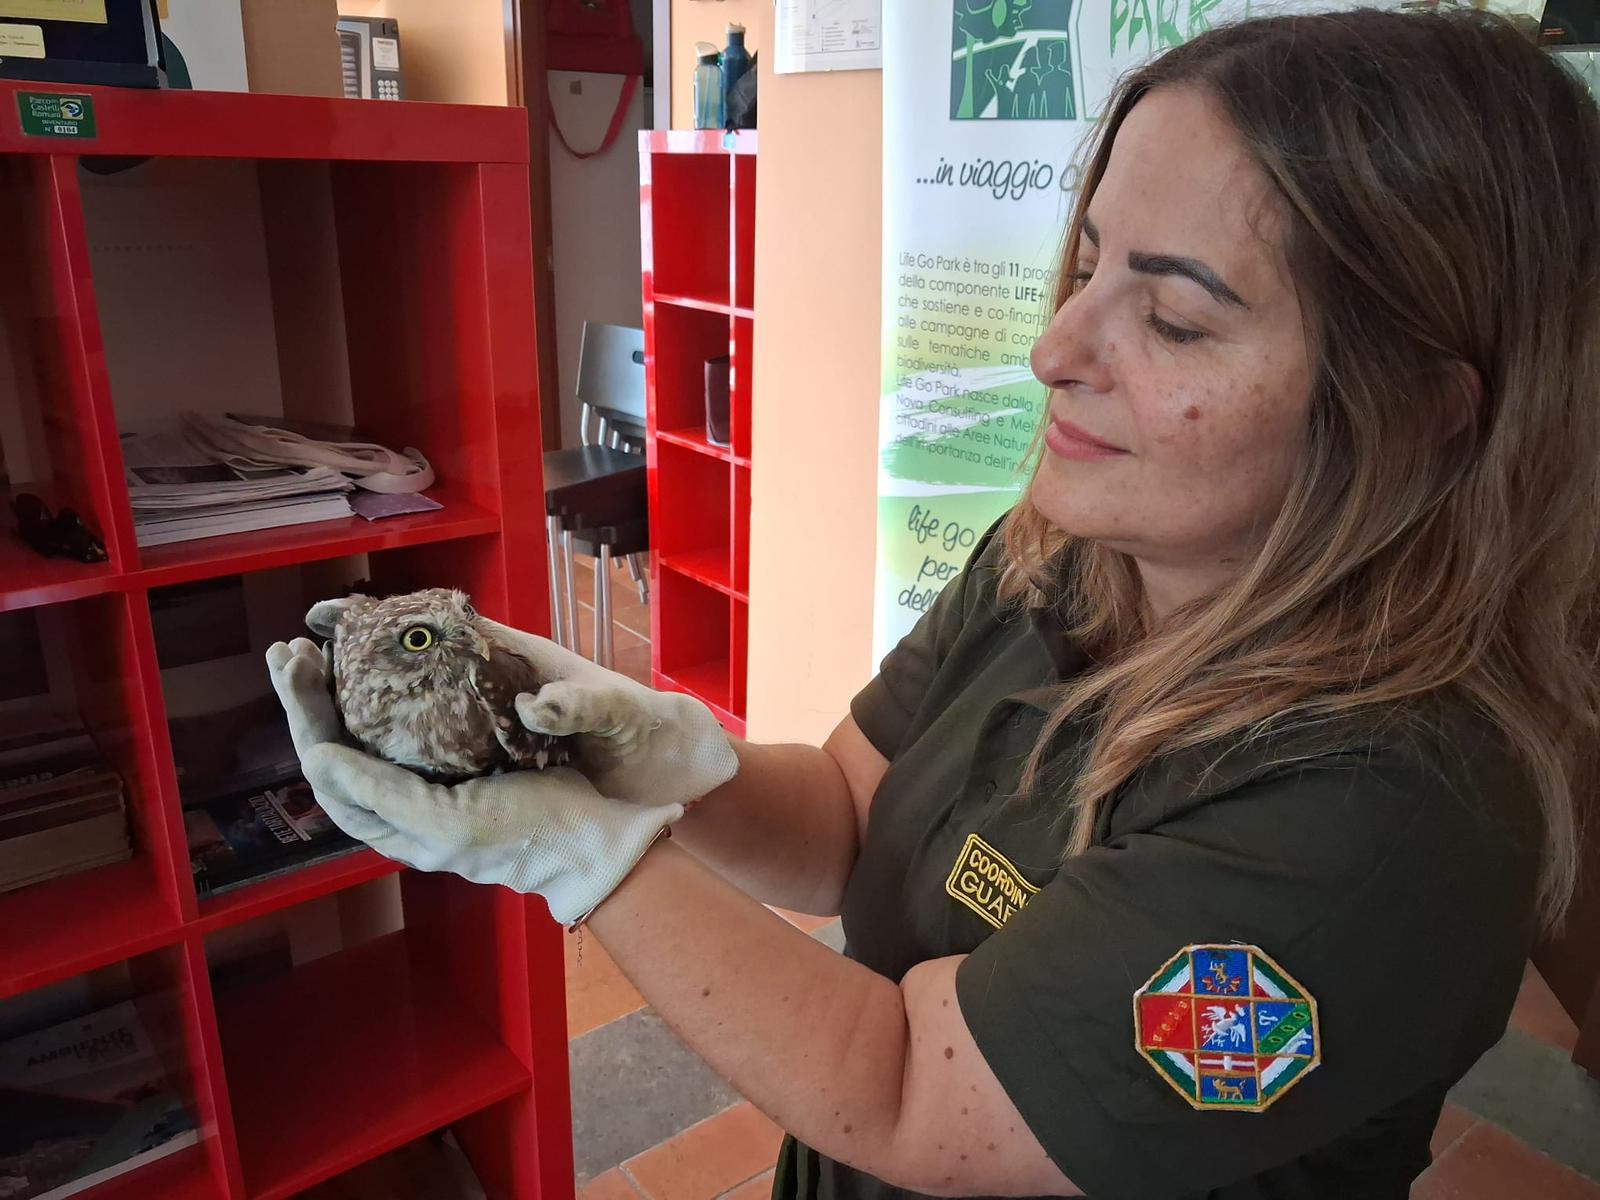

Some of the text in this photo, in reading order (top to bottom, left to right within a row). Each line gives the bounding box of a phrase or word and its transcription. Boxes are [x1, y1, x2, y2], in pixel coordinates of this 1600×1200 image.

[959, 158, 1053, 200] viaggio
[899, 252, 915, 267] Life
[917, 254, 935, 269] Go
[936, 256, 960, 272] Park
[963, 257, 971, 273] è
[974, 259, 990, 274] tra
[992, 261, 1006, 280] gli
[1009, 262, 1019, 278] 11
[898, 272, 1045, 302] della componente LIFE+
[898, 294, 919, 309] che
[922, 299, 970, 316] sostiene
[975, 306, 983, 318] e
[920, 320, 989, 341] campagne
[995, 328, 1007, 344] di
[929, 340, 990, 361] tematiche
[915, 377, 932, 393] Go
[935, 380, 960, 397] Park
[962, 389, 999, 405] nasce
[1002, 394, 1033, 412] dalla
[896, 393, 923, 410] Nova
[928, 400, 990, 426] Consulting
[996, 416, 1004, 427] e
[963, 428, 991, 446] Aree
[908, 505, 975, 552] life go
[917, 556, 958, 582] per
